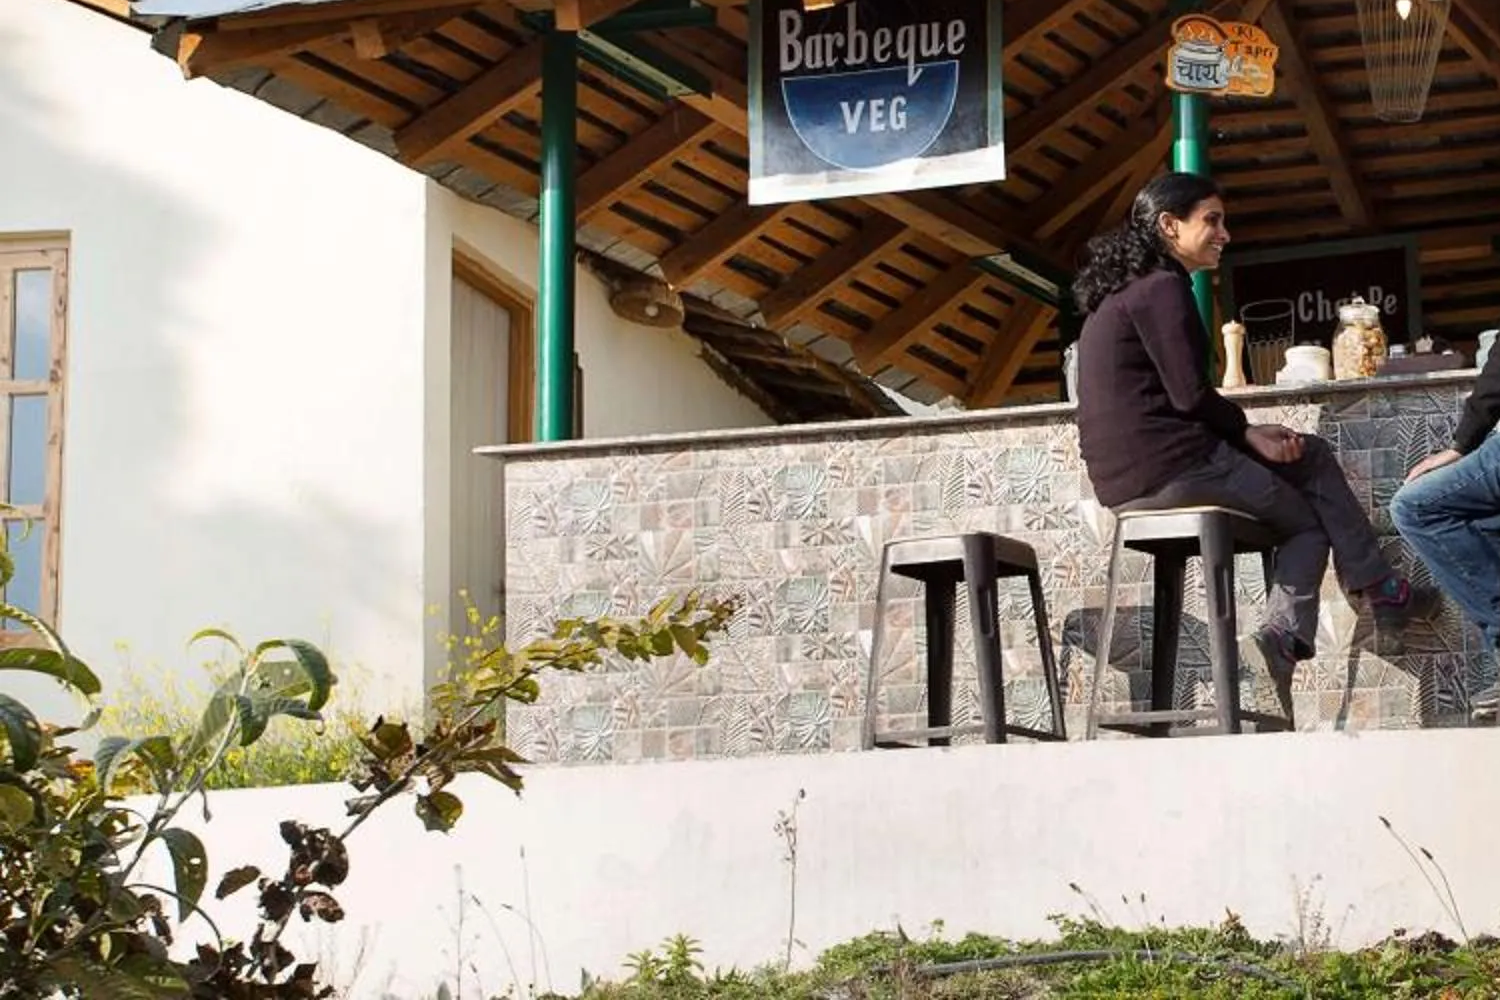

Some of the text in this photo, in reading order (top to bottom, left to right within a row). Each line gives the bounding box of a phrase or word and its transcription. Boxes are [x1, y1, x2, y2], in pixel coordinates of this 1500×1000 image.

[778, 2, 966, 87] Barbeque
[839, 96, 909, 135] VEG
[1297, 289, 1358, 324] Ch
